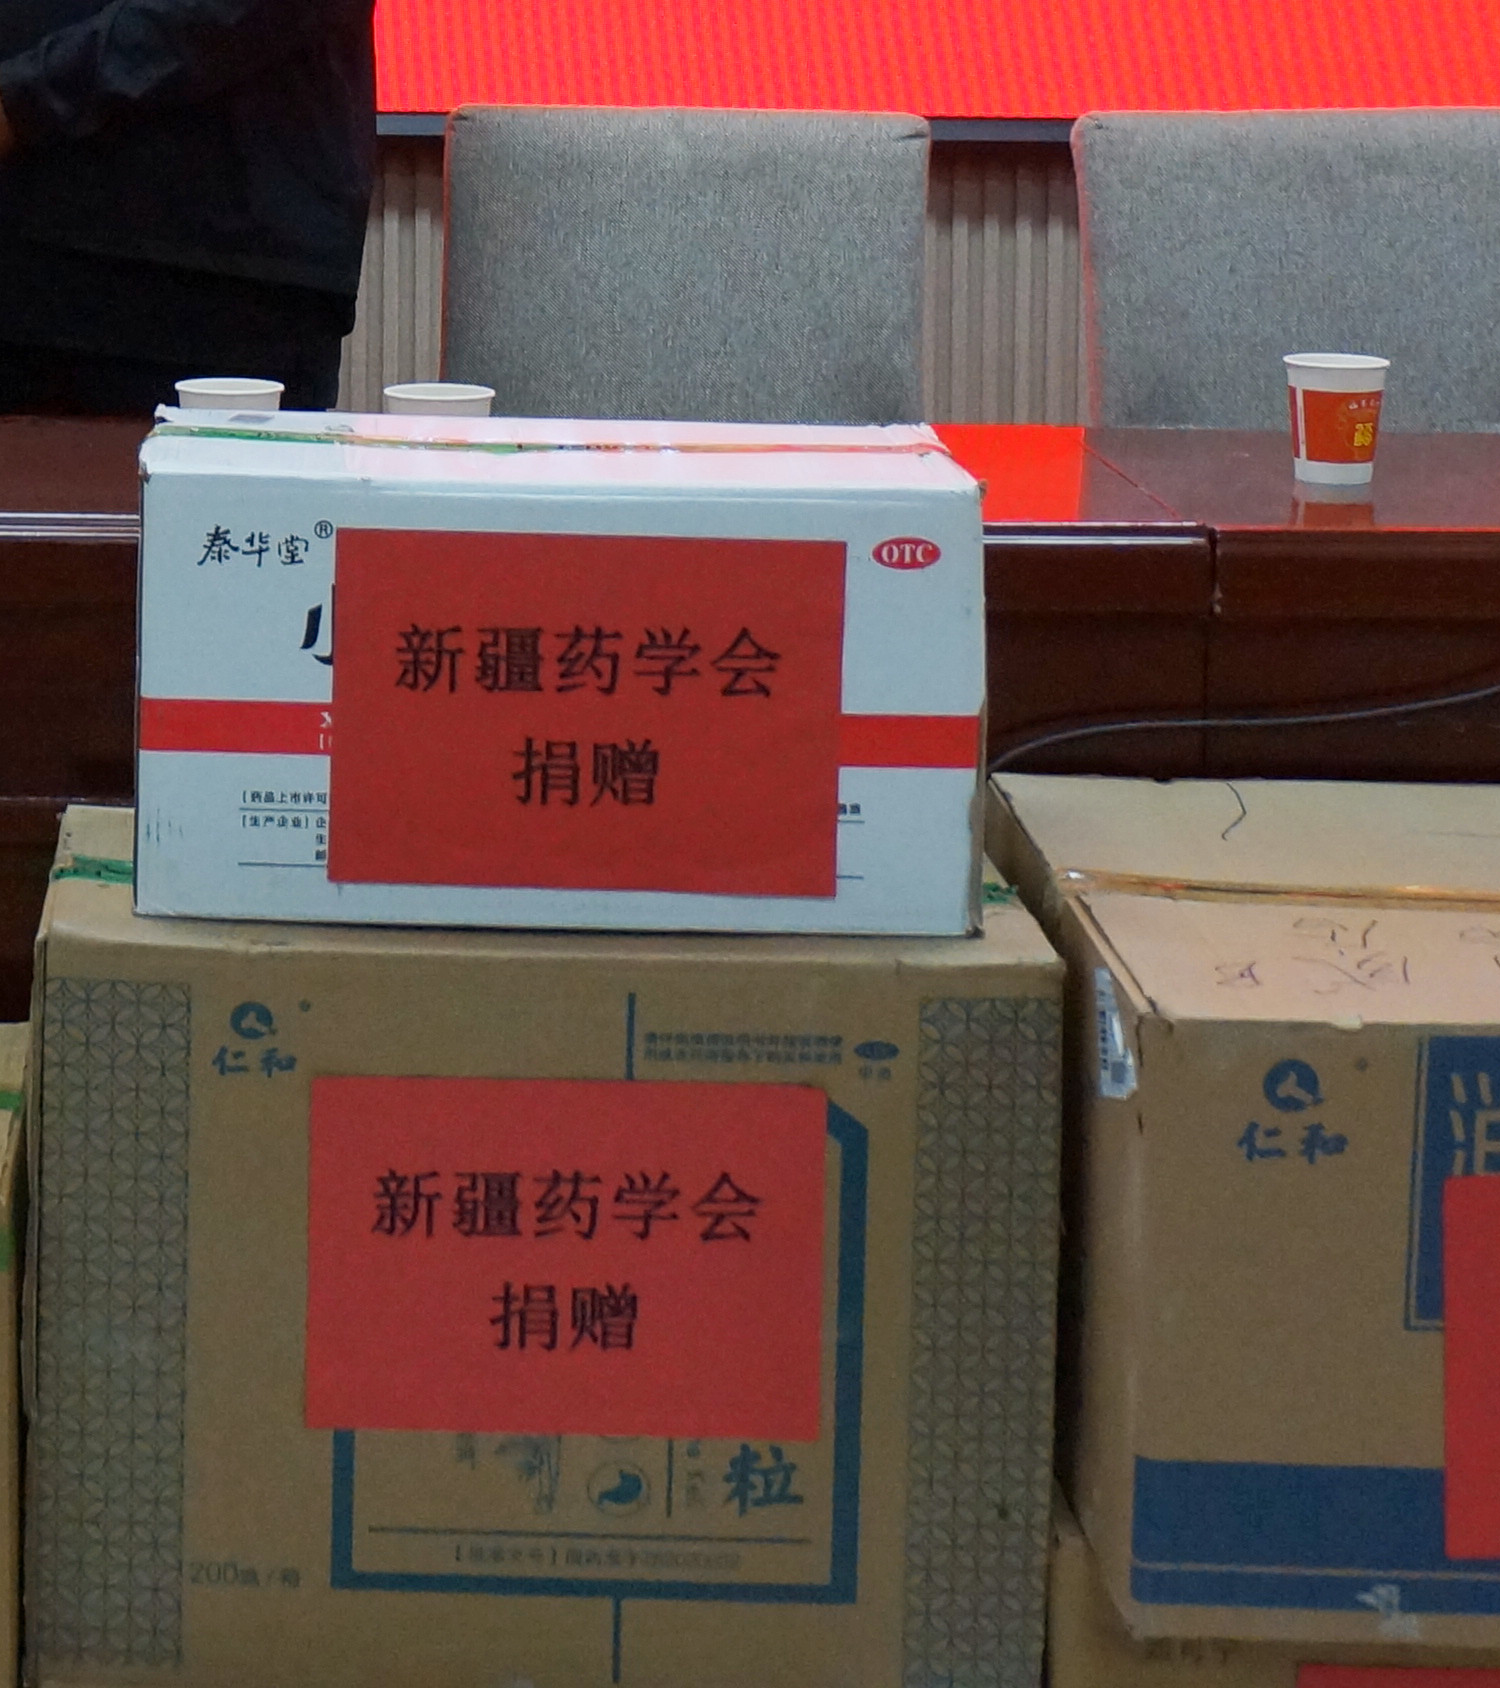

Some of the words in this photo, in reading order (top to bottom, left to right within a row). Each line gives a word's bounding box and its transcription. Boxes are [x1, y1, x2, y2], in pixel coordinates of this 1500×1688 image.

[196, 524, 310, 568] 泰华堂
[881, 543, 934, 564] OTC
[395, 623, 781, 698] 新疆药学会
[511, 737, 660, 808] 捐赠
[211, 1045, 299, 1079] 仁和
[1236, 1121, 1349, 1165] 仁和
[372, 1169, 762, 1243] 新疆药学会
[490, 1281, 639, 1352] 捐赠
[722, 1443, 805, 1517] 粒
